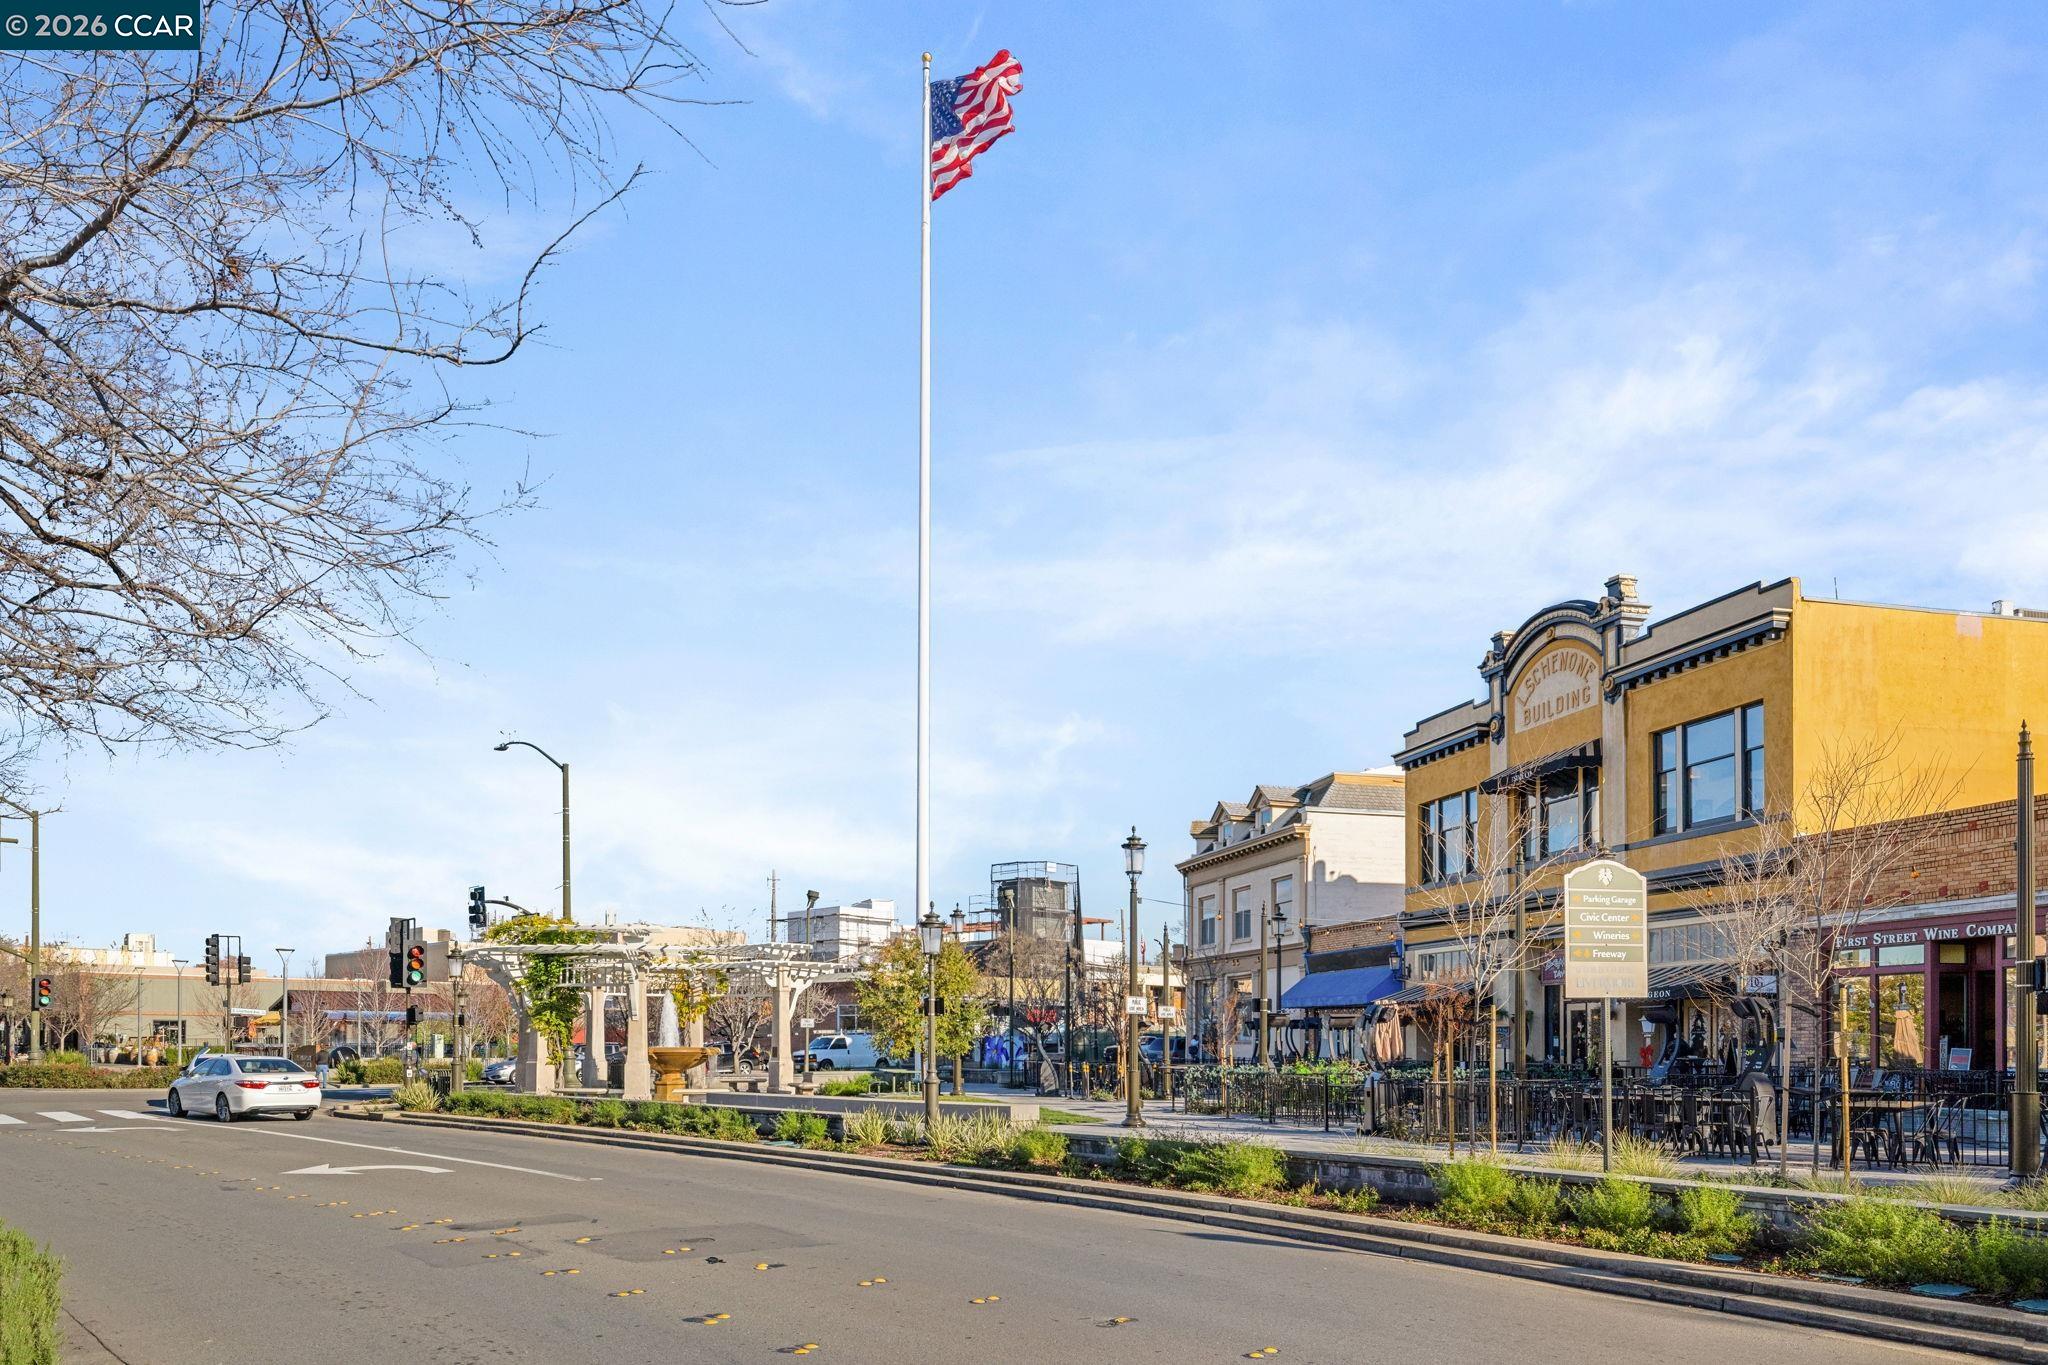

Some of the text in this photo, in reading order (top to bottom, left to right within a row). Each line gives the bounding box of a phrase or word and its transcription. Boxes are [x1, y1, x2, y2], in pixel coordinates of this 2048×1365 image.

[1525, 651, 1596, 695] SCHENONE
[1524, 685, 1591, 726] BUILDING
[1583, 894, 1637, 907] Parking Garage
[1580, 912, 1630, 922] Civic Center
[1593, 930, 1630, 941] Wineries
[1873, 932, 1918, 945] STREET
[1923, 927, 1959, 941] WINE
[1966, 923, 2018, 937] COMPA
[1592, 949, 1627, 961] Freeway
[1648, 989, 1671, 999] GEON
